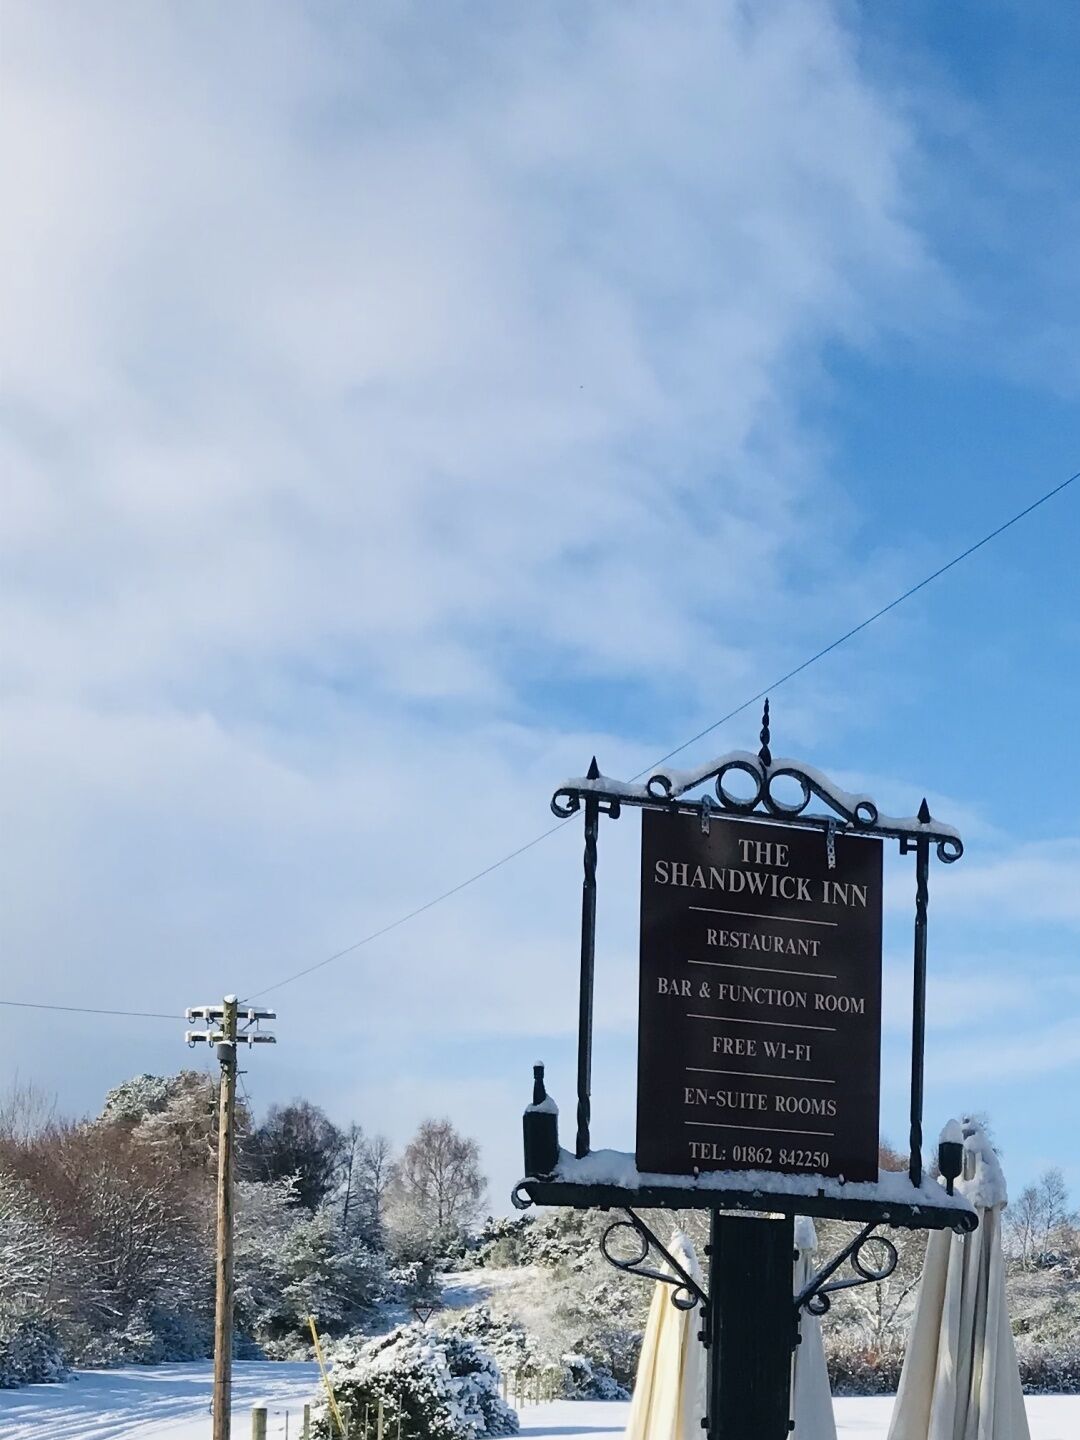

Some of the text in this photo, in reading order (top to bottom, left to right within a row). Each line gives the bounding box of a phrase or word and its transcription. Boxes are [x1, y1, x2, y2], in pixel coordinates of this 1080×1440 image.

[738, 838, 790, 868] THE
[654, 860, 868, 908] SHANDWICK INN
[706, 928, 821, 957] RESTAURANT
[657, 977, 865, 1014] BAR & FUNCTION ROOM
[712, 1036, 812, 1062] FREE WI-FI
[684, 1087, 837, 1117] EN-SUITE ROOMS
[688, 1141, 829, 1169] TEL: 01862 842250
